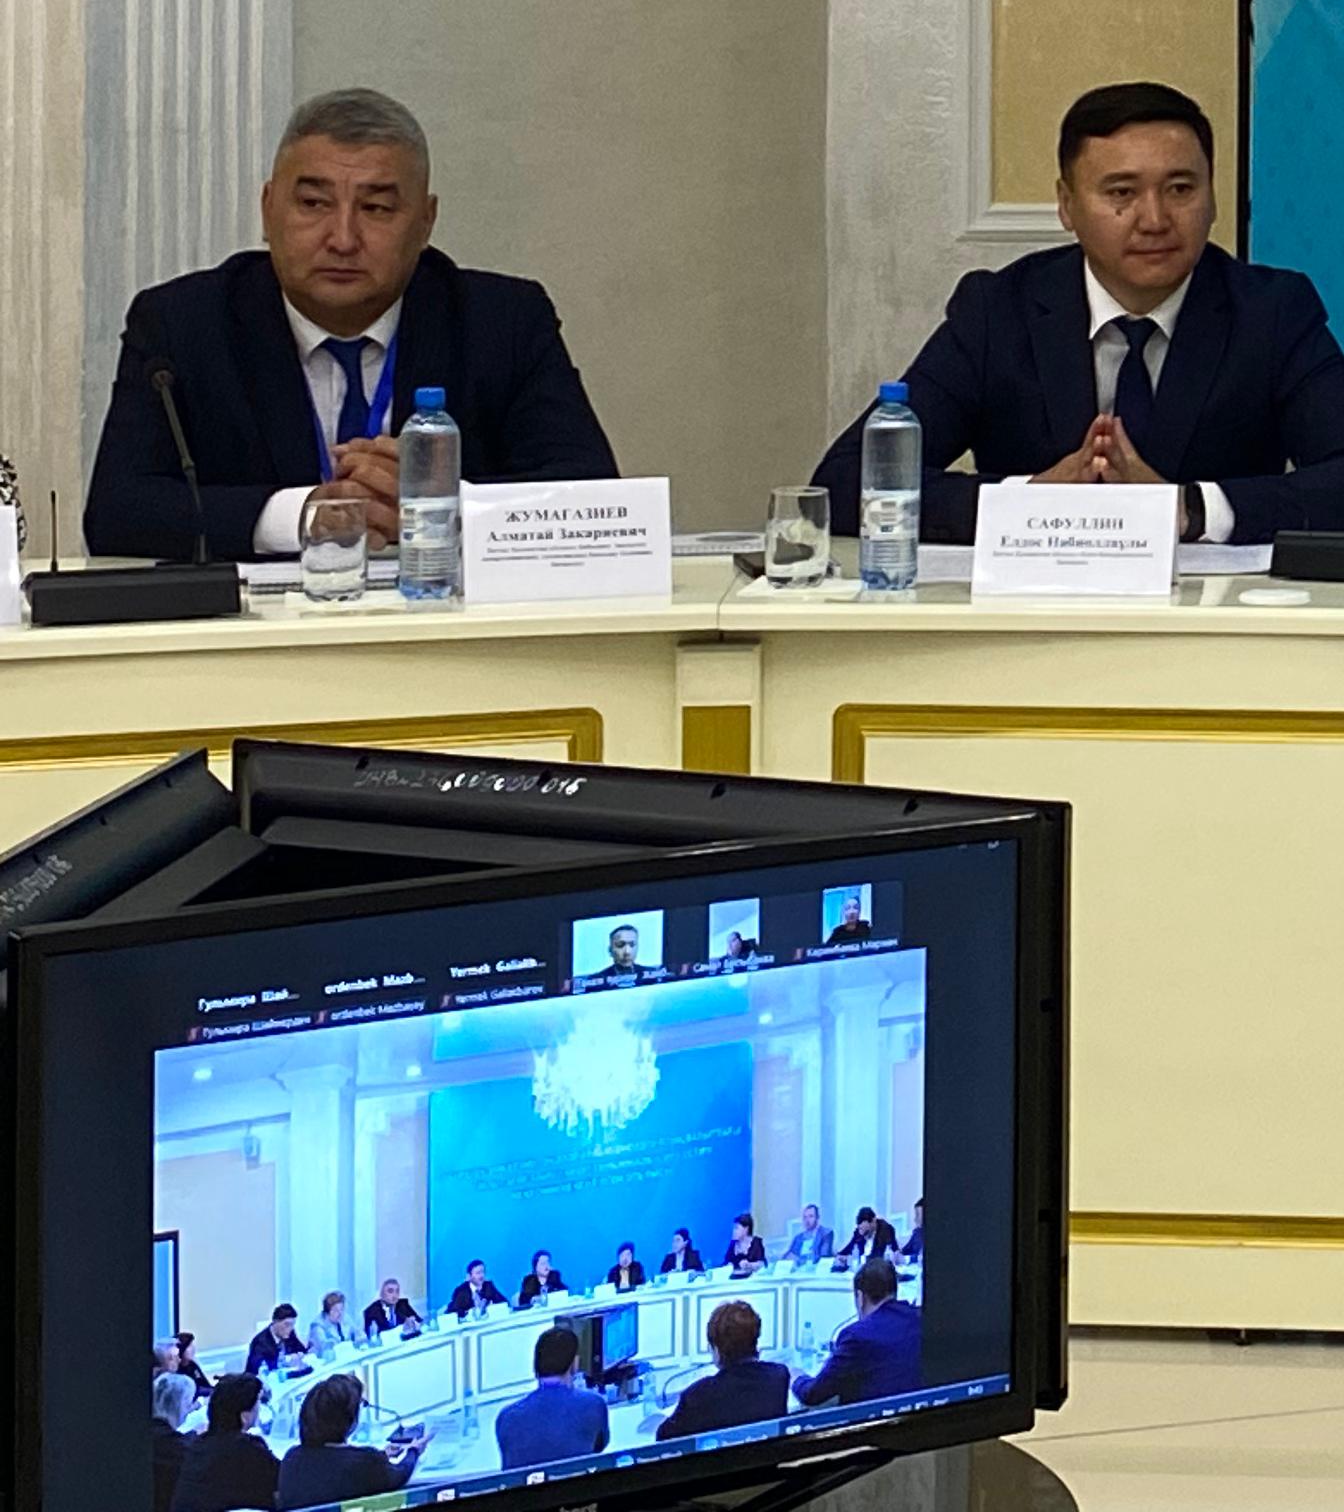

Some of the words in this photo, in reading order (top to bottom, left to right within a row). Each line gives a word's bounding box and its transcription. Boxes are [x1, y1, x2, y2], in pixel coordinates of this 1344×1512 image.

[505, 506, 628, 523] ЖУМАГАЗИЕВ
[1026, 517, 1124, 530] САФУЛЛИН
[487, 528, 554, 542] Алматай
